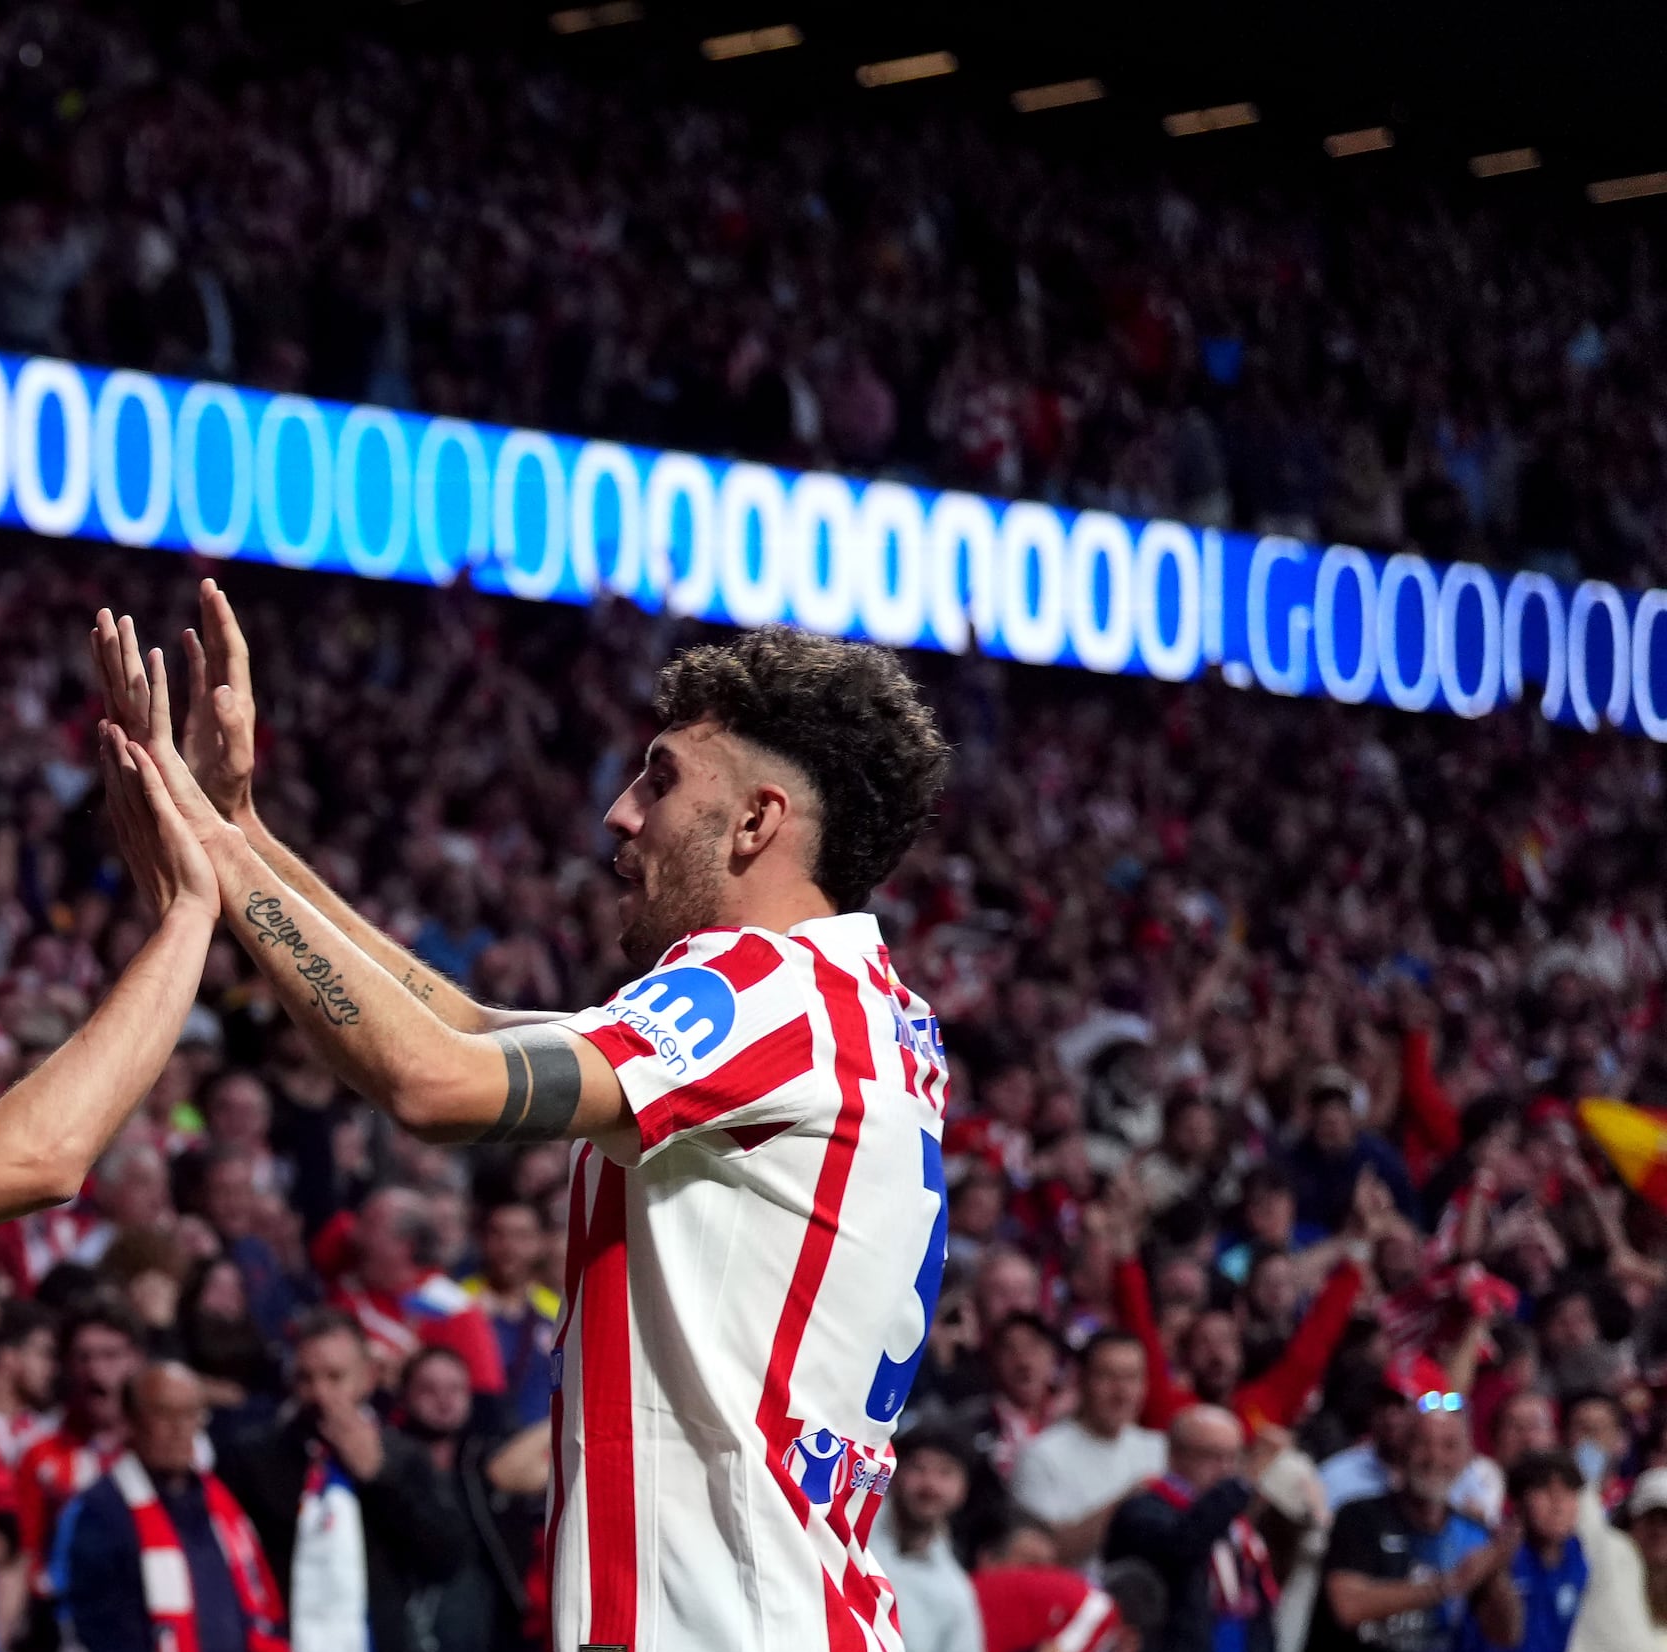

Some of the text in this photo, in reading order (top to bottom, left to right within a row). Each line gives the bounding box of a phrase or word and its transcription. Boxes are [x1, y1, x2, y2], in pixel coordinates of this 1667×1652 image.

[245, 891, 361, 1026] Carpe Diem
[606, 1004, 687, 1076] kraken
